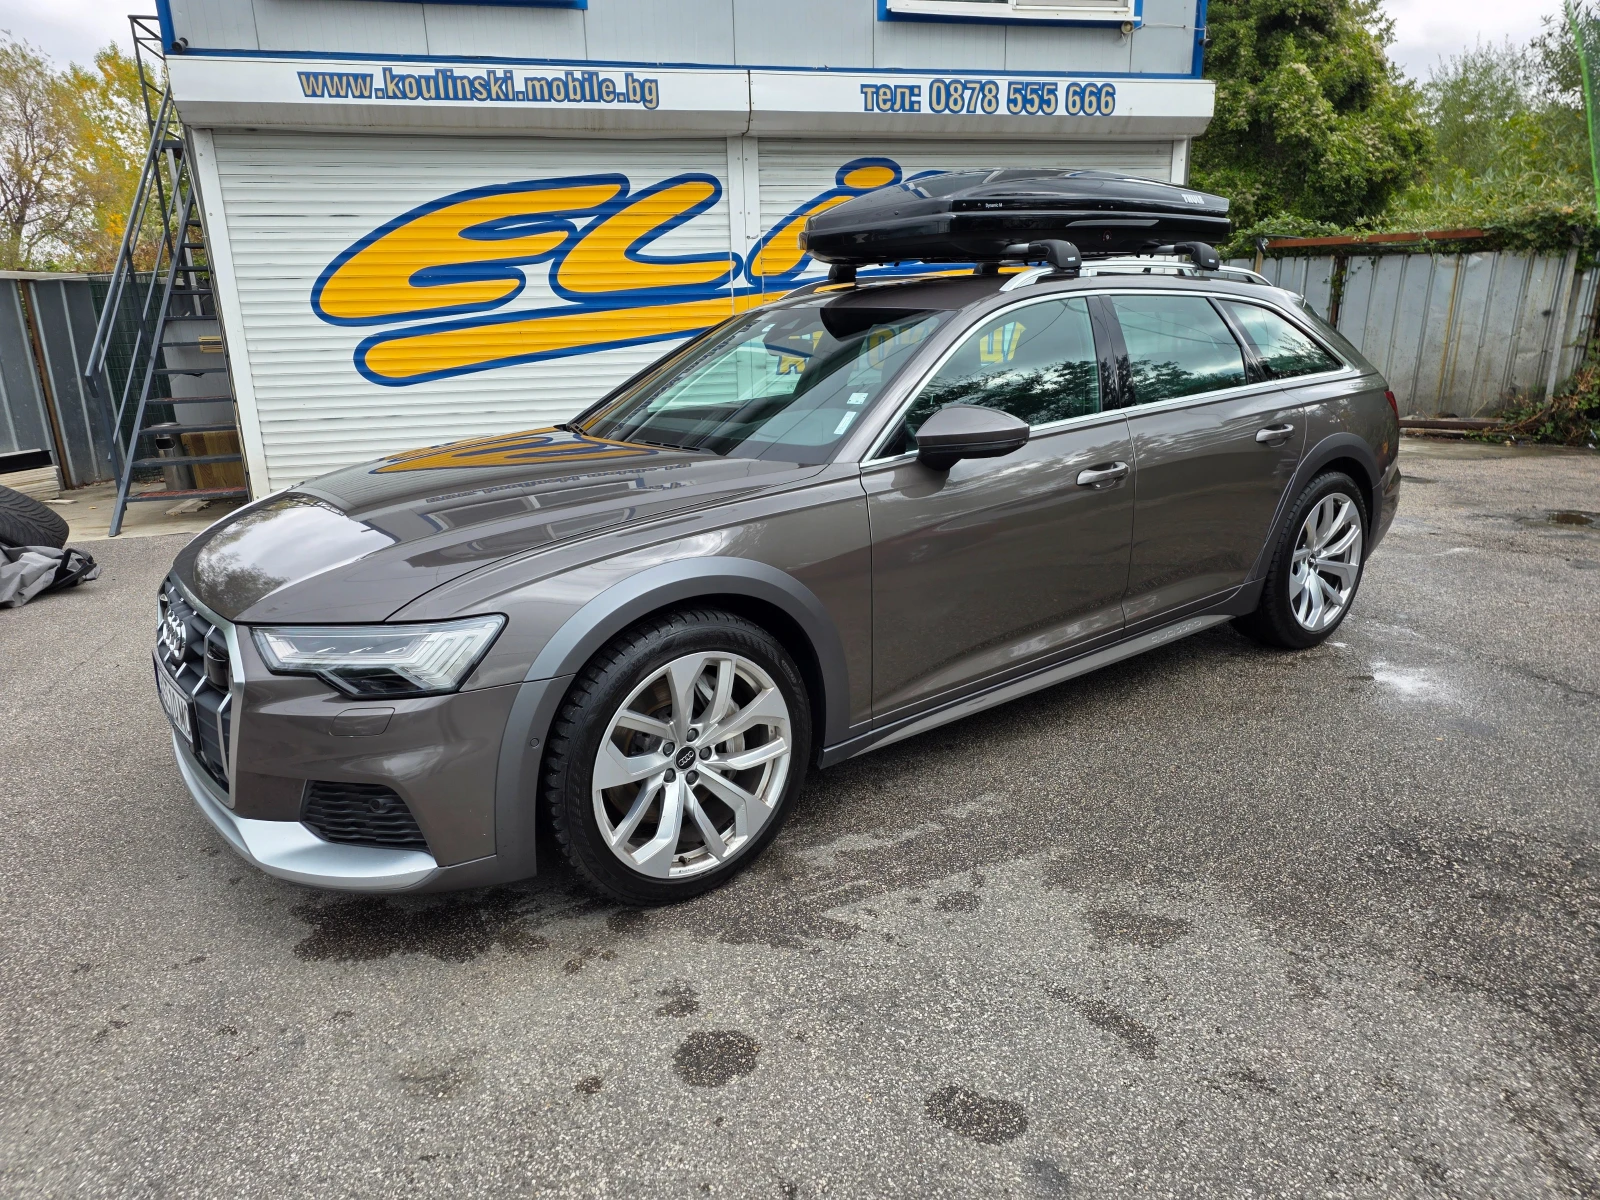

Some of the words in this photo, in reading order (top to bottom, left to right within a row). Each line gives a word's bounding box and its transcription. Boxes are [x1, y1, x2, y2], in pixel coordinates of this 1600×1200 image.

[297, 67, 660, 110] www.koulinski.mobile.bg
[861, 84, 921, 113] тел:
[929, 79, 999, 115] 0878
[1007, 81, 1058, 116] 555
[1065, 82, 1116, 117] 666
